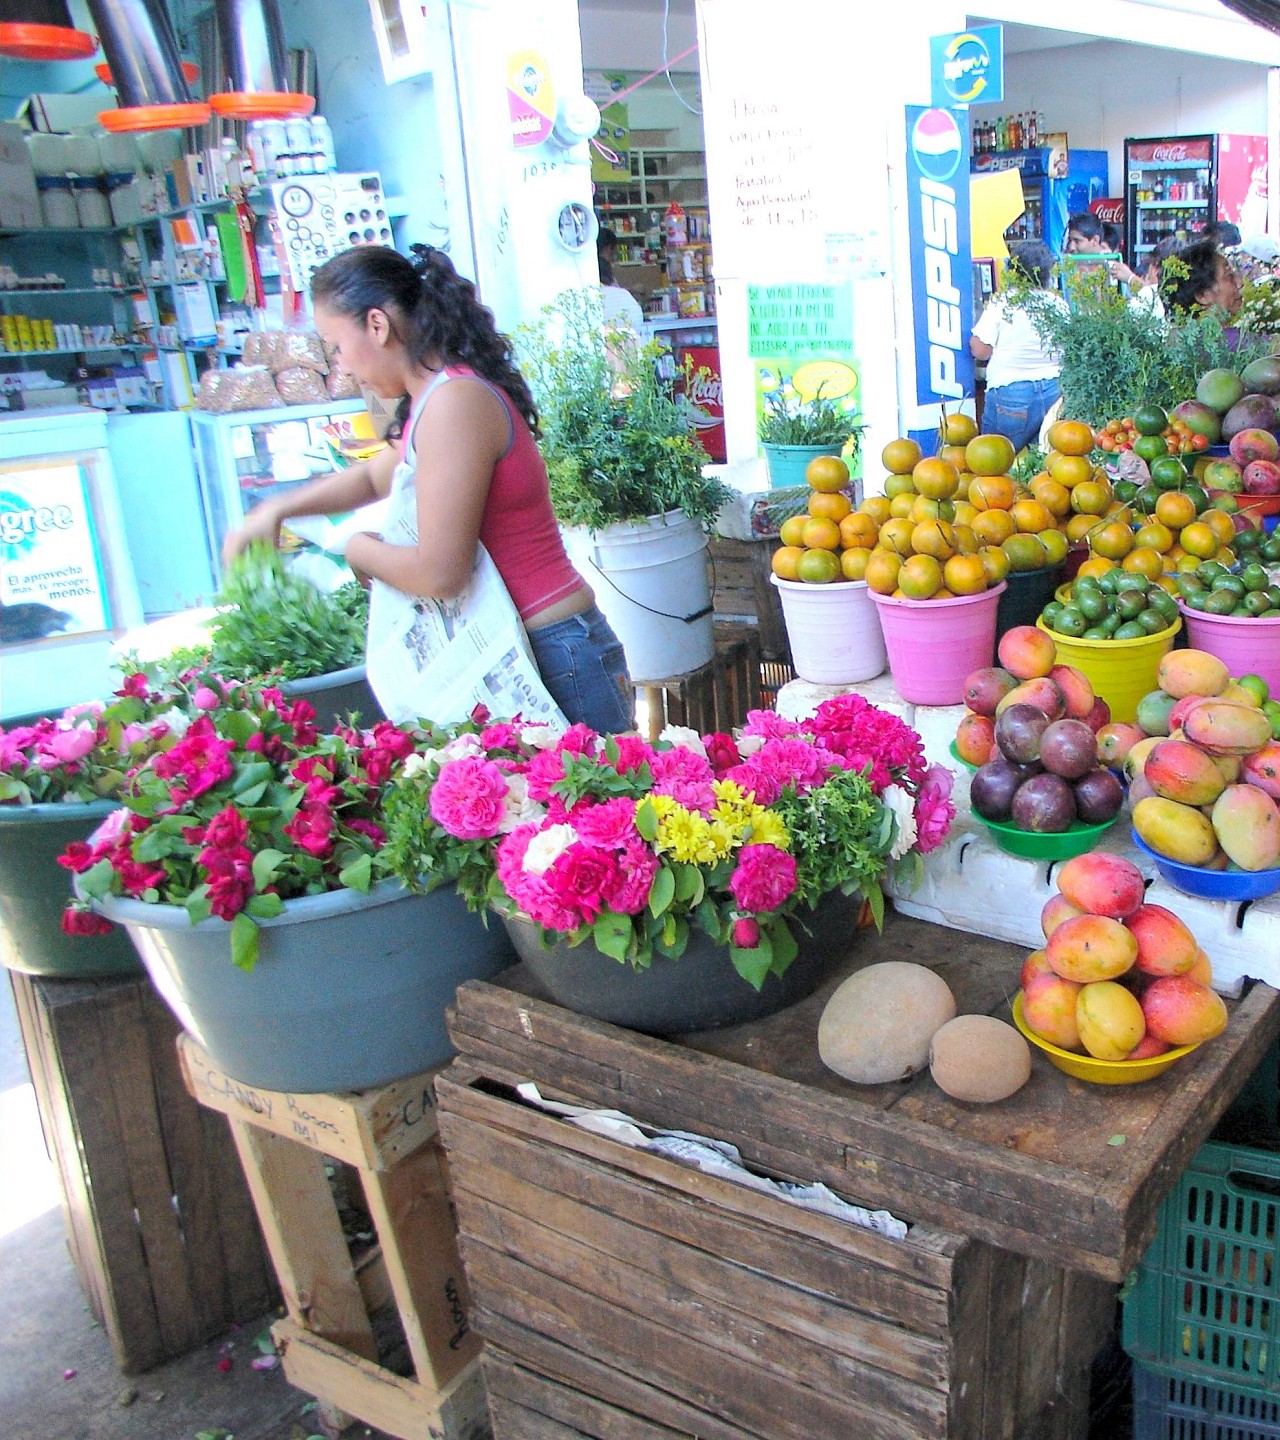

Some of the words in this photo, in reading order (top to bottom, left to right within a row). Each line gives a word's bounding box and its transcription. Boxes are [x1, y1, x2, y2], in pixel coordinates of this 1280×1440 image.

[1152, 146, 1186, 162] Coca-Cola
[523, 162, 557, 183] 1030
[990, 159, 1026, 171] PEPSI
[920, 177, 964, 399] PEPSI
[0, 504, 74, 545] gree
[8, 575, 18, 586] El
[23, 566, 83, 586] aprovecha
